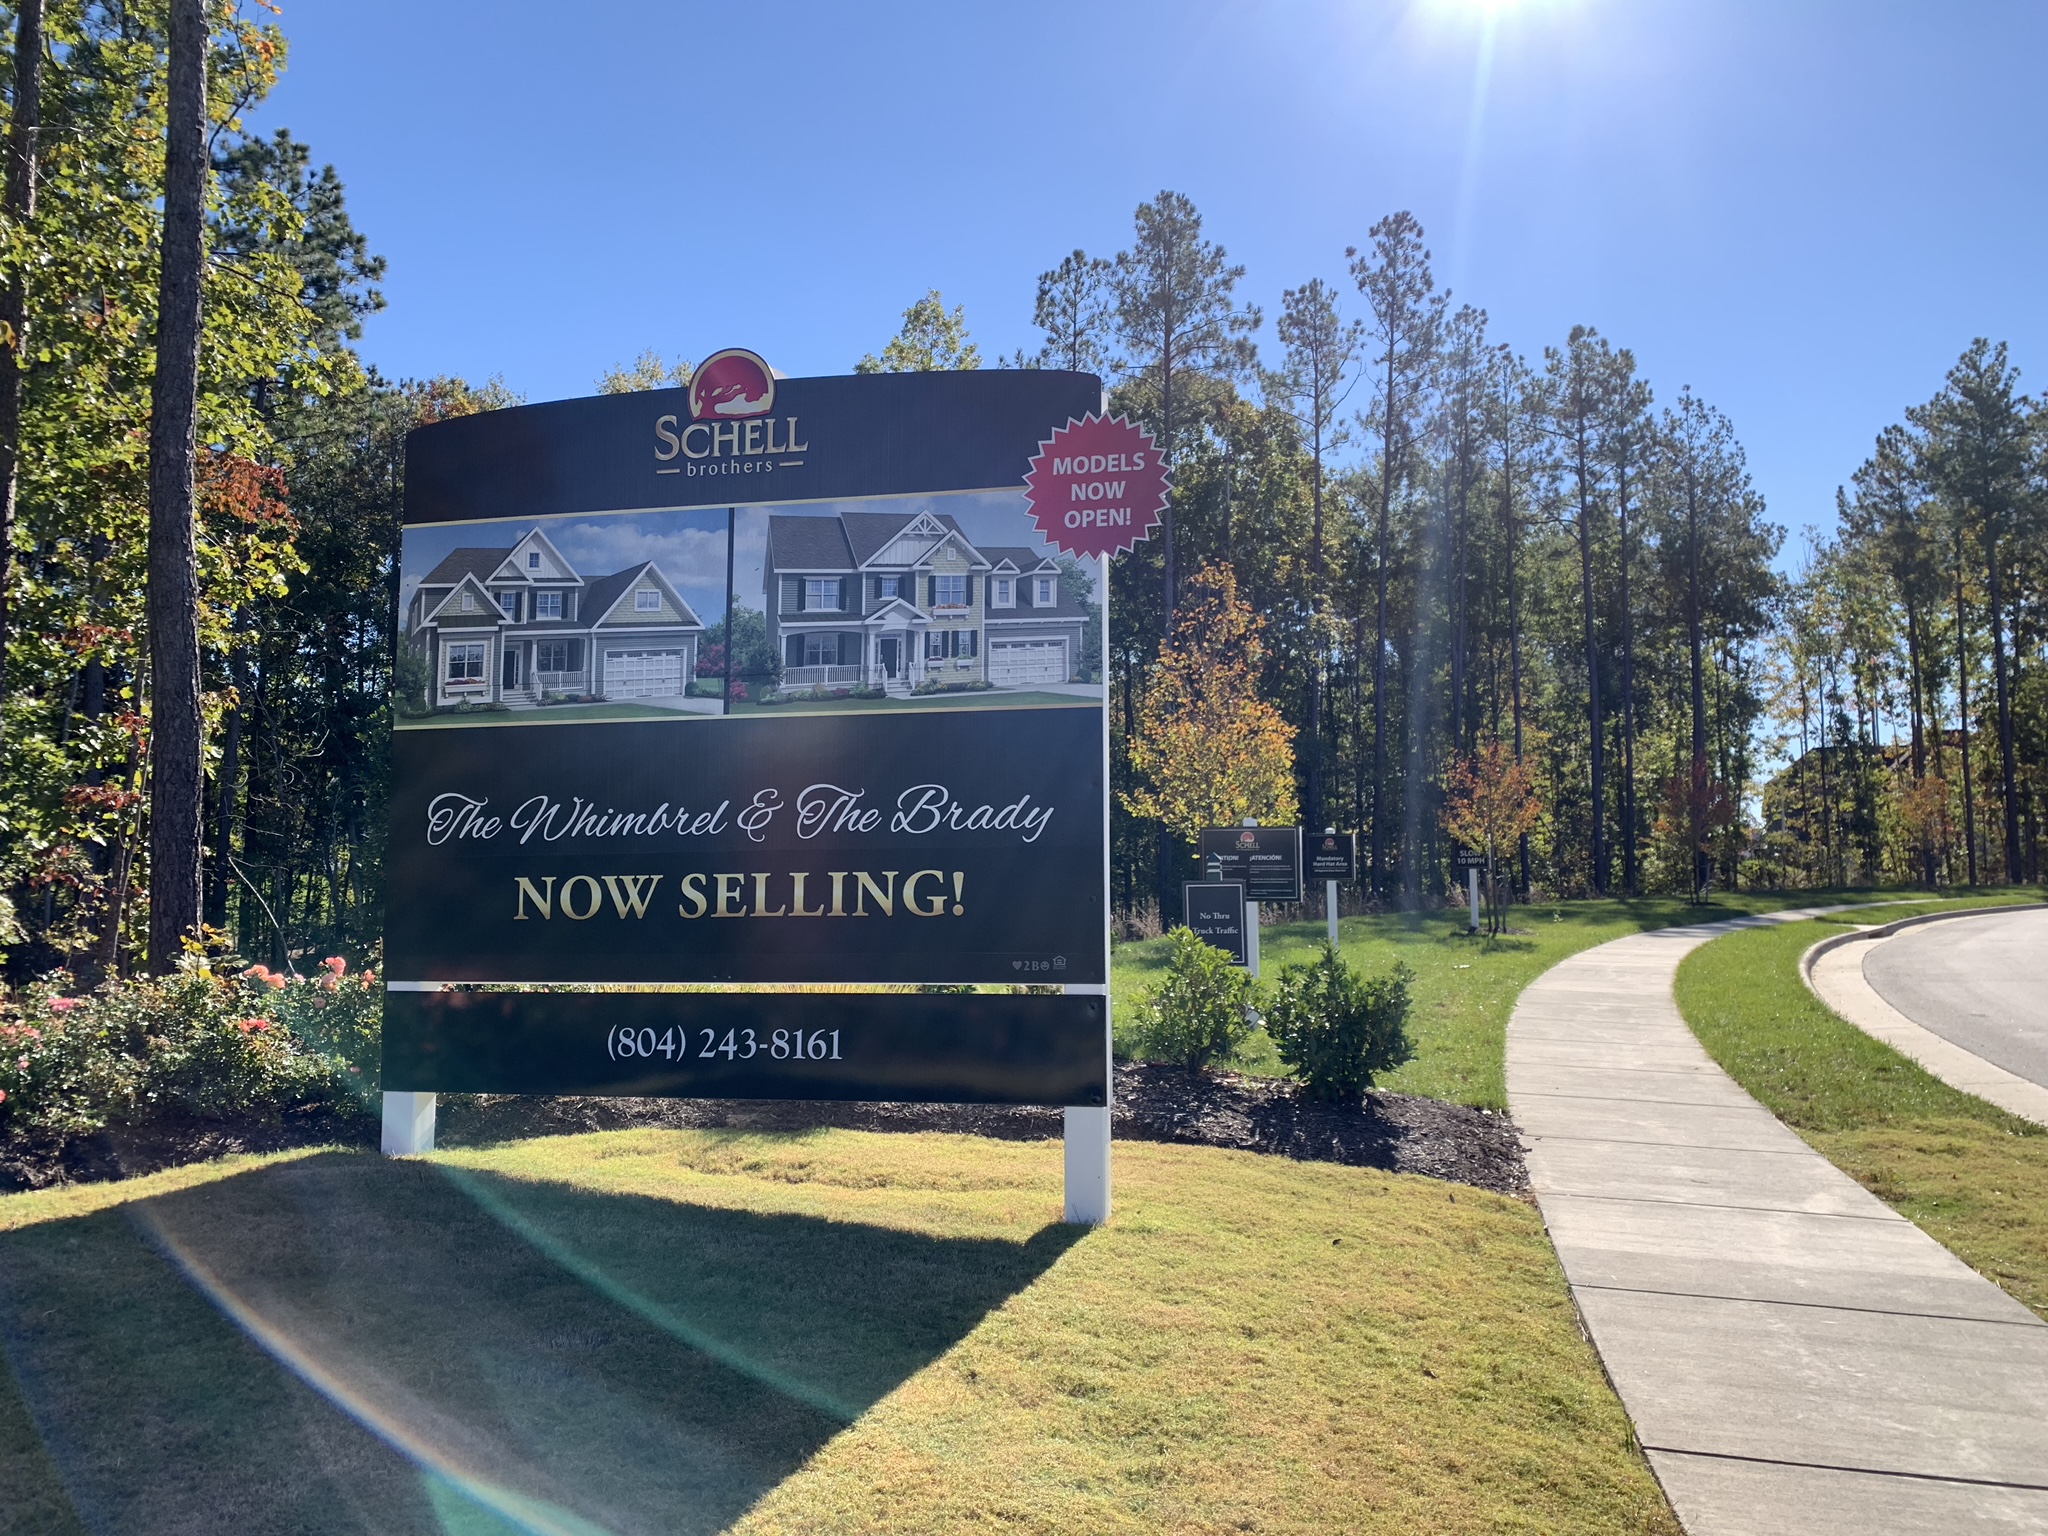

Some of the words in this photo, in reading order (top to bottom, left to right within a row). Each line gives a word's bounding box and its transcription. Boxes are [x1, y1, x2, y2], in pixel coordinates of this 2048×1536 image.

[654, 414, 809, 461] SCHELL
[687, 459, 773, 477] brothers
[1052, 452, 1146, 476] MODELS
[1071, 480, 1127, 502] NOW
[1064, 507, 1132, 529] OPEN!
[426, 792, 503, 846] The
[510, 795, 730, 845] Whimbrel
[736, 788, 784, 842] &
[796, 783, 882, 839] The
[890, 784, 1055, 843] Brady
[1235, 840, 1260, 849] SCHELL
[513, 873, 664, 921] NOW
[678, 869, 965, 919] SELLING!
[1199, 912, 1212, 920] No
[1212, 912, 1231, 920] Thru
[1192, 926, 1214, 934] Truck
[1215, 926, 1239, 934] Traffic
[607, 1024, 687, 1062] (804)
[698, 1027, 843, 1061] 243-8161
